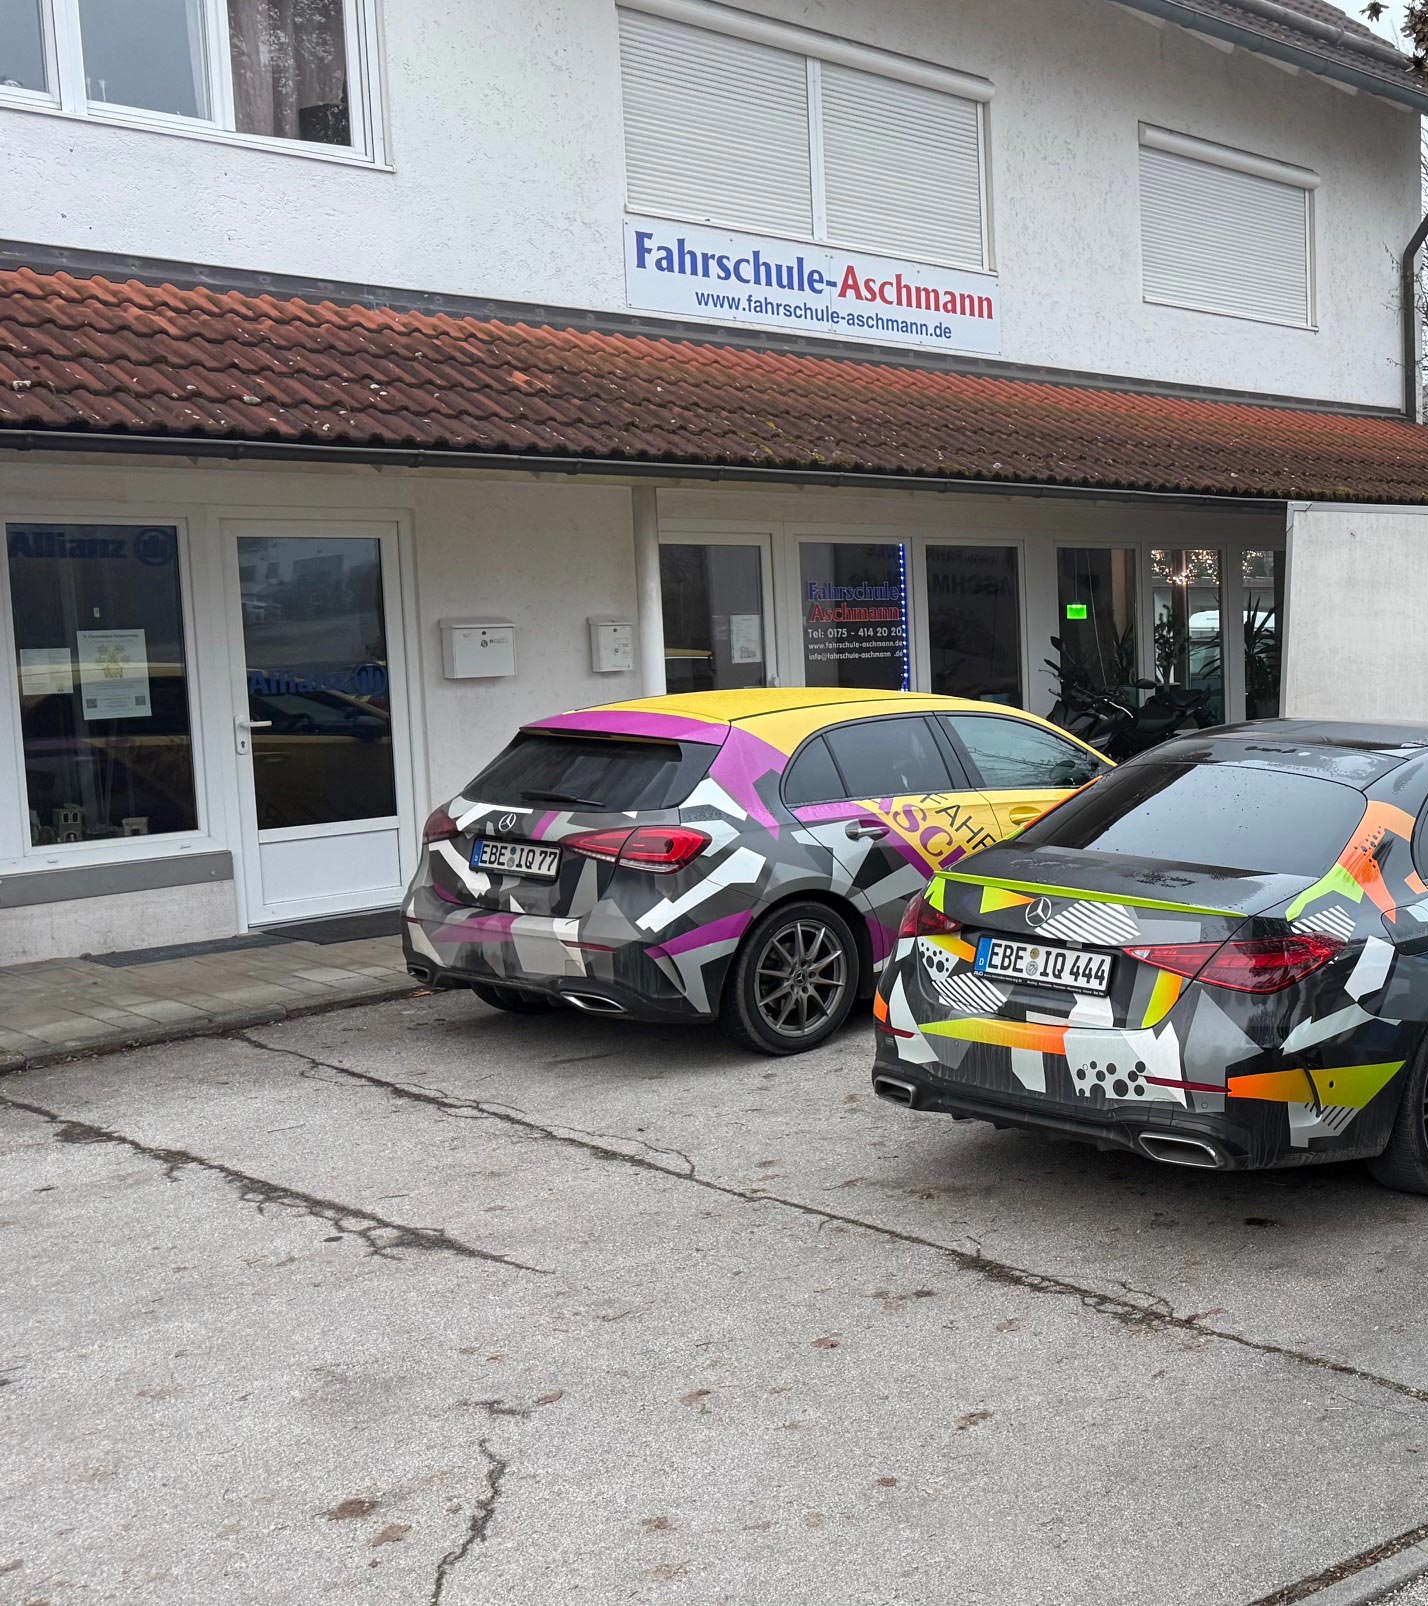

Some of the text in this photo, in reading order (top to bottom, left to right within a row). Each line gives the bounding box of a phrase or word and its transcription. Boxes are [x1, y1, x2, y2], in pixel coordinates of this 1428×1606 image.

[635, 231, 994, 320] Fahrschule-Aschmann
[695, 291, 952, 339] www.fahrschule-aschmann.de
[9, 532, 128, 559] Allianz
[808, 581, 900, 601] Fahrschule
[809, 602, 901, 622] Aschmann
[808, 629, 824, 639] Tel:
[827, 628, 848, 638] 0175
[858, 627, 874, 637] 414
[877, 627, 888, 636] 20
[891, 626, 903, 636] 20
[808, 640, 903, 649] www.fahrschule-aschmann.de
[249, 669, 347, 695] Allianz
[480, 843, 508, 866] EBE
[515, 848, 536, 870] IQ
[538, 850, 558, 872] 77
[979, 943, 1106, 986] D EBE IQ 444
